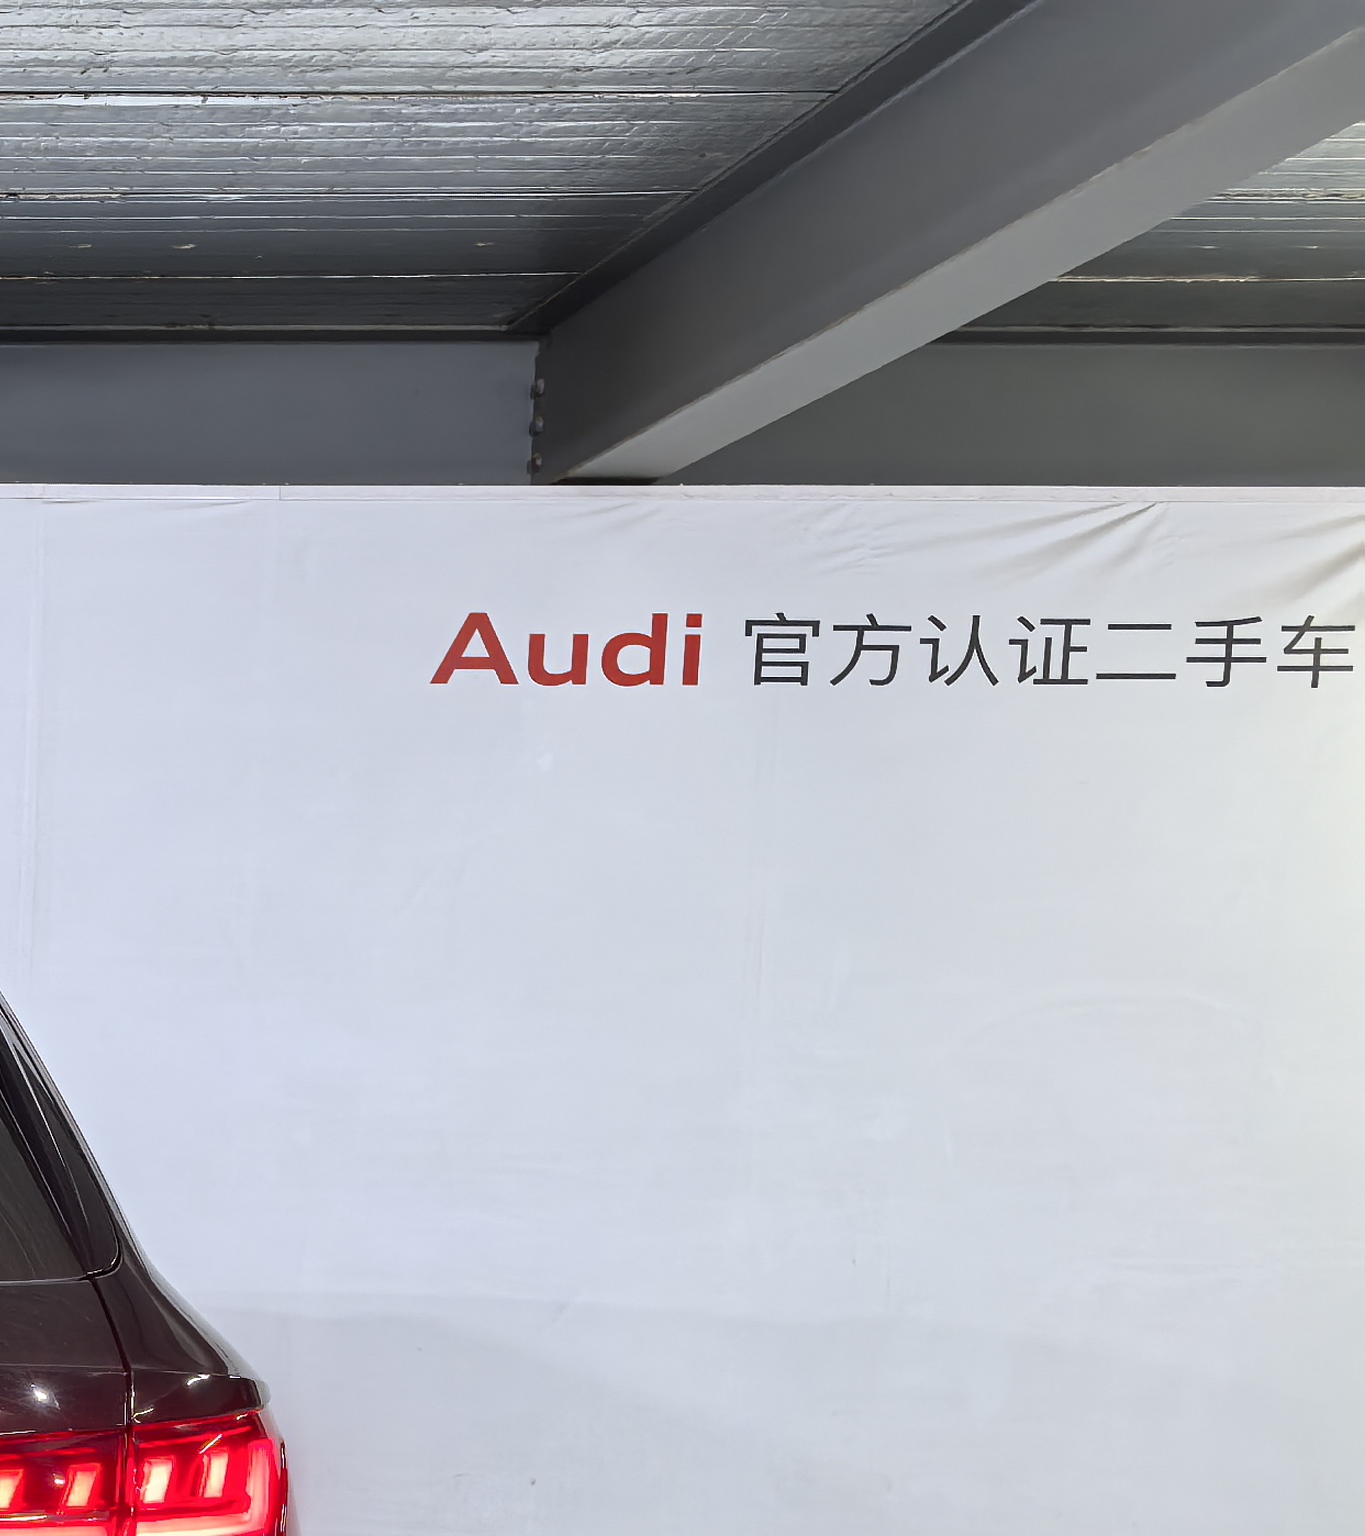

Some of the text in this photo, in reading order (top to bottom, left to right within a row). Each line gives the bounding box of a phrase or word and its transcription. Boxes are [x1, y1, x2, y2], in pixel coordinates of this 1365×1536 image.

[429, 612, 1357, 689] Audi 官方认证二手车
